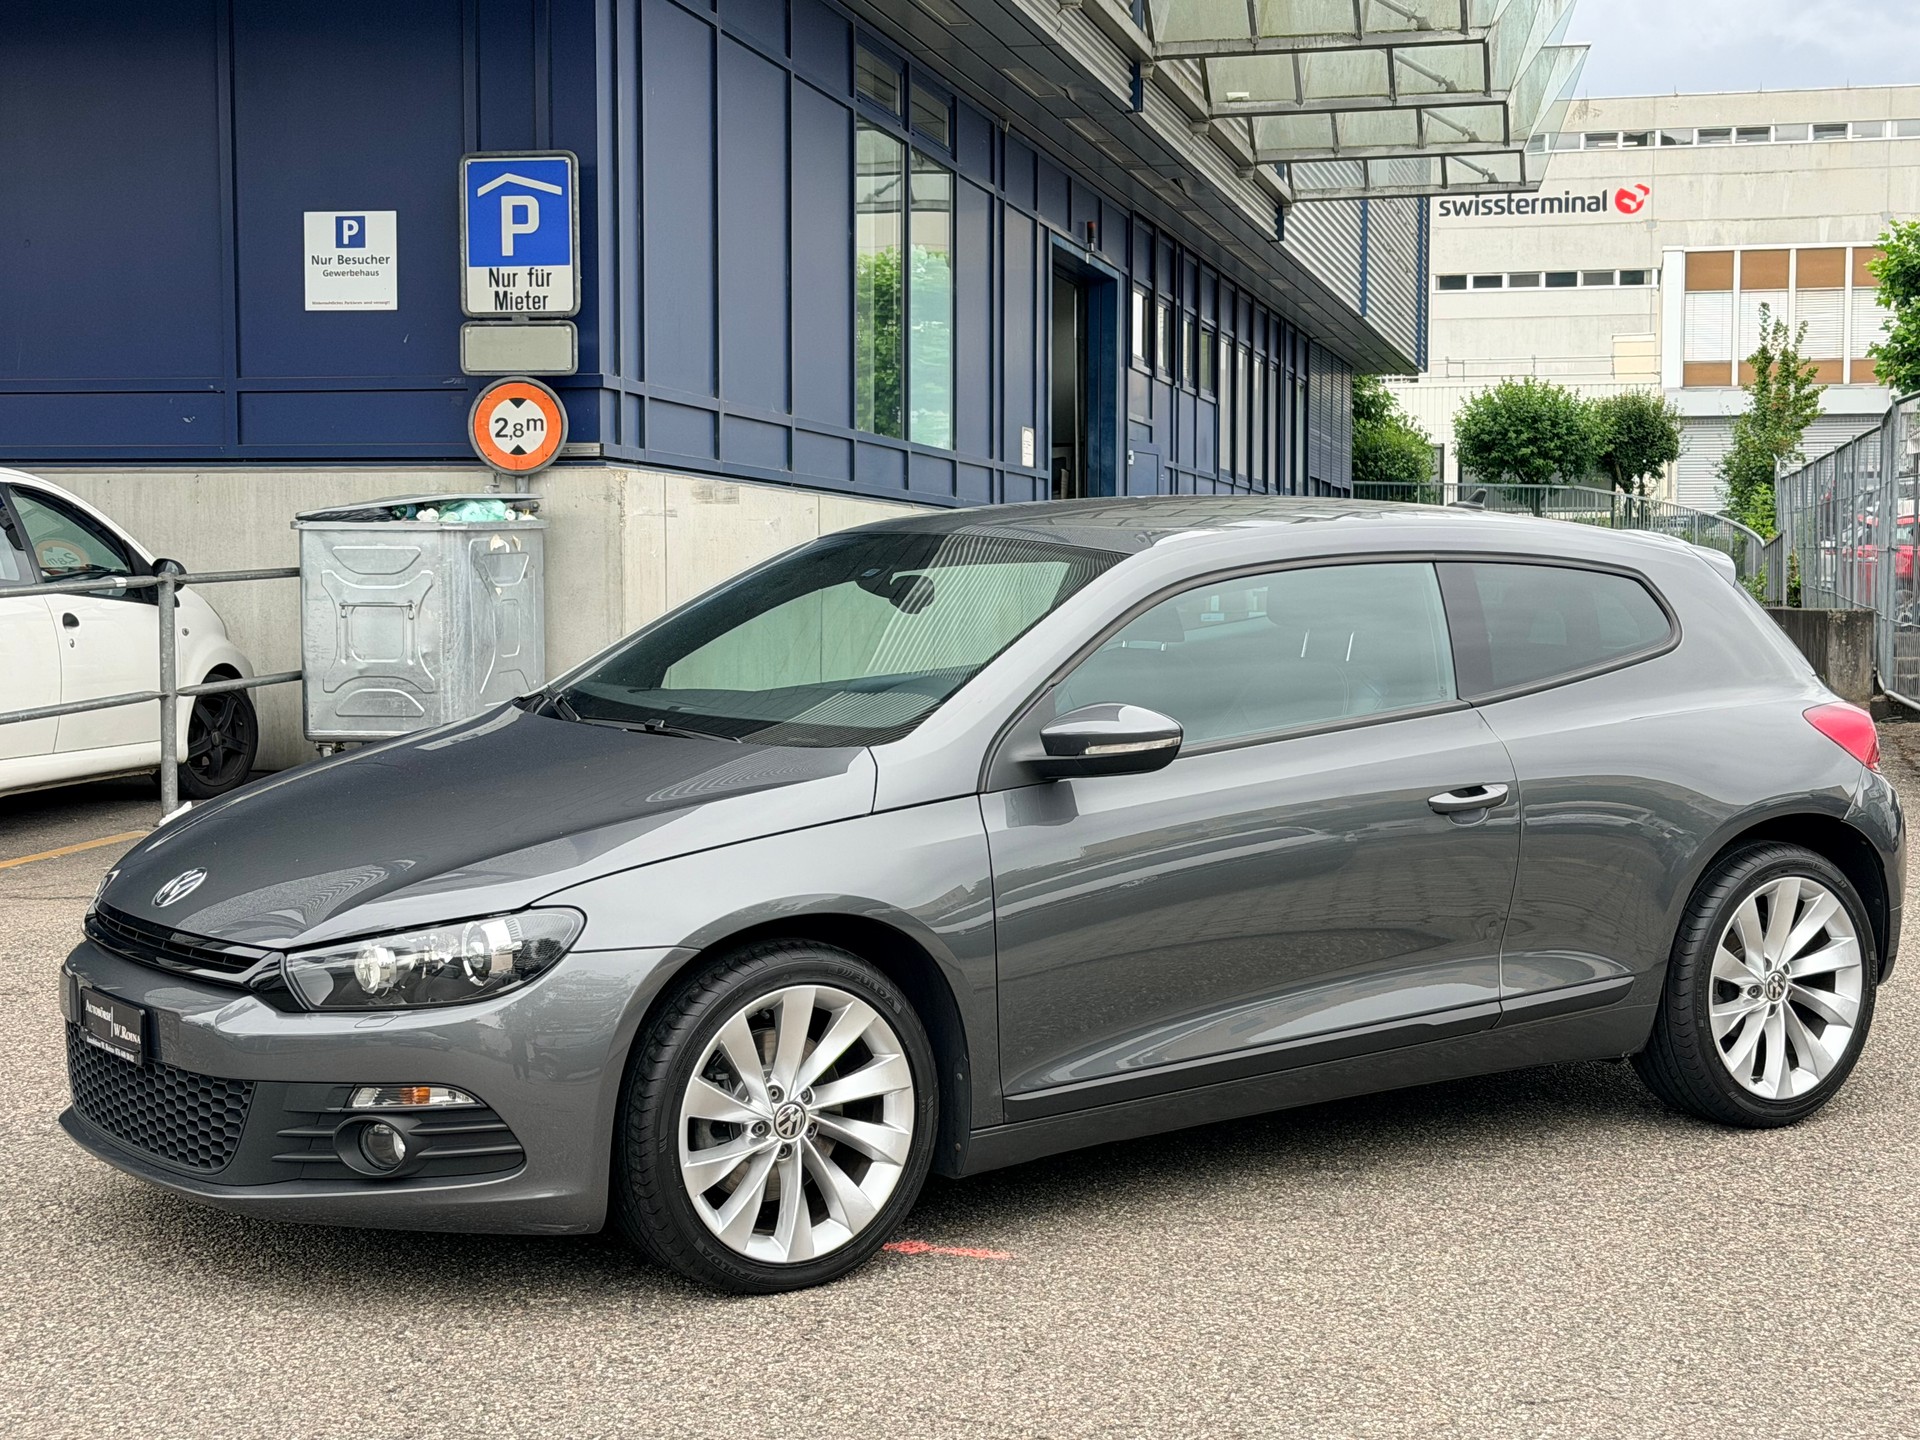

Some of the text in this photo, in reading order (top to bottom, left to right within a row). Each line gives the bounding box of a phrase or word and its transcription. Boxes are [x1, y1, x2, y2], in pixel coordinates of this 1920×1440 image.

[1438, 189, 1608, 217] swissterminal
[342, 219, 360, 245] P
[501, 195, 540, 257] P
[311, 254, 390, 265] Nur Besucher
[322, 269, 380, 277] Gewerbehaus
[488, 267, 552, 288] Nur für
[494, 290, 549, 311] Mieter
